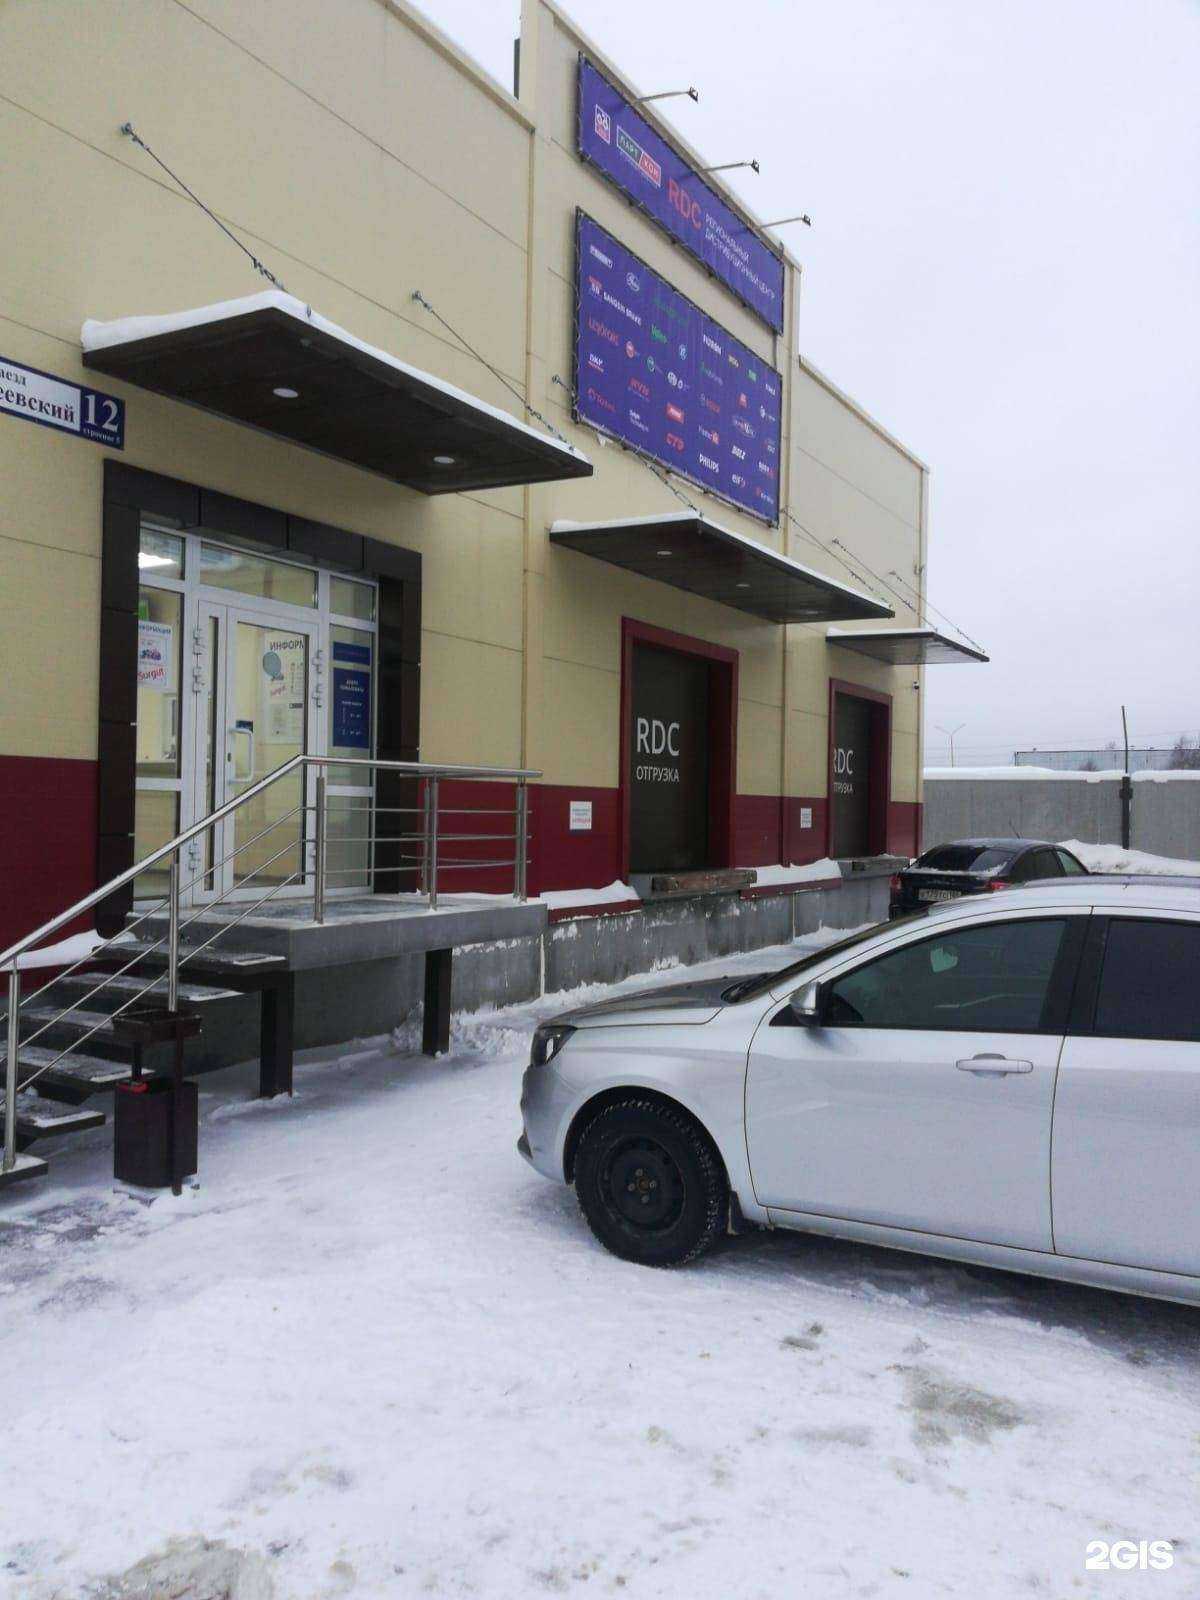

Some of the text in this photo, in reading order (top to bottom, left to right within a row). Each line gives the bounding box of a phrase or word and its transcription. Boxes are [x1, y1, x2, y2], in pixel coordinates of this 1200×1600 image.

[667, 177, 702, 229] RDC
[85, 394, 119, 432] 12
[699, 453, 720, 473] PHILIPS
[637, 717, 680, 756] RDC
[636, 765, 680, 782] ОТГРУЗКА
